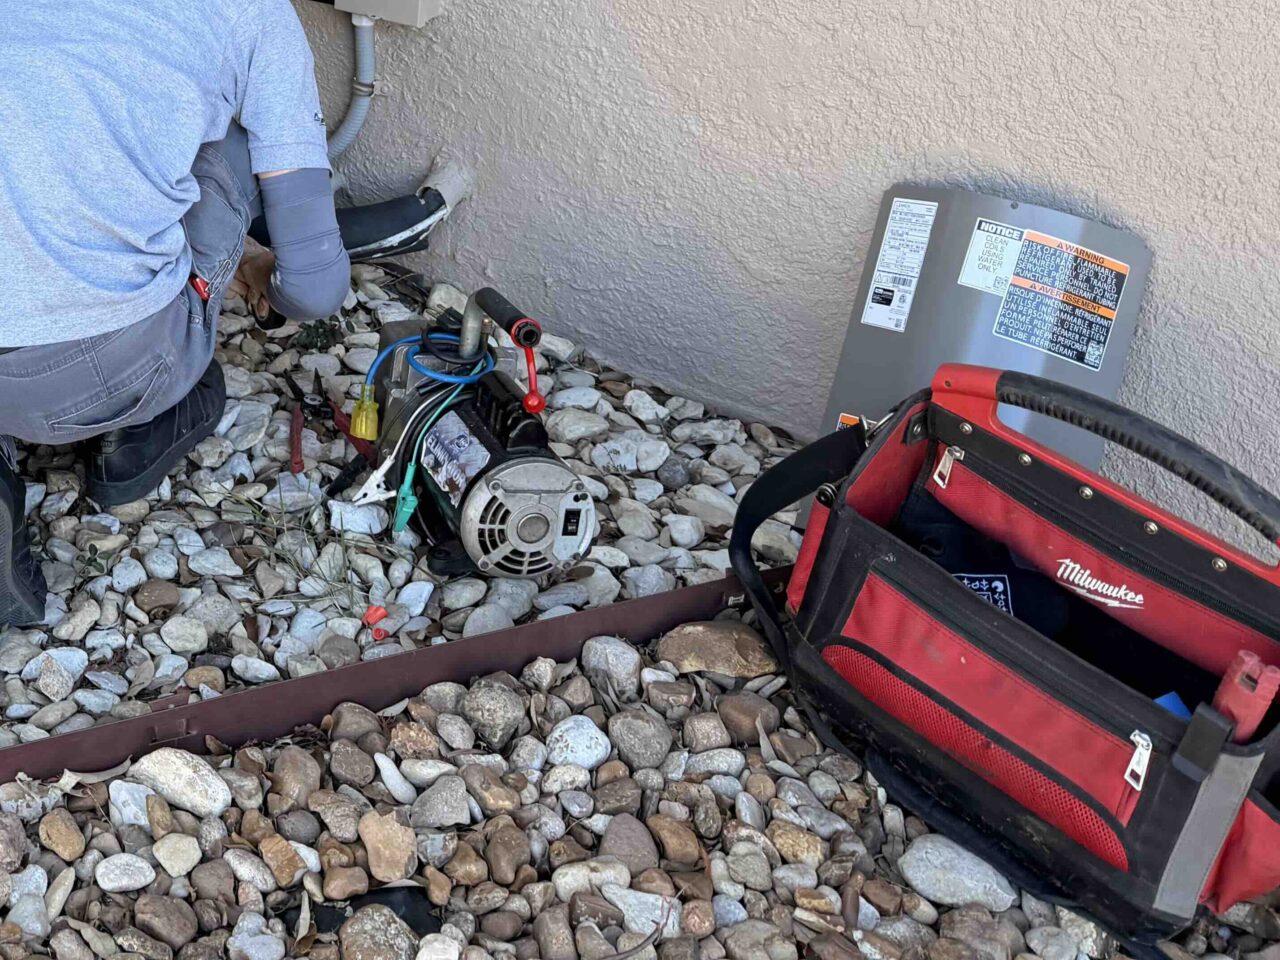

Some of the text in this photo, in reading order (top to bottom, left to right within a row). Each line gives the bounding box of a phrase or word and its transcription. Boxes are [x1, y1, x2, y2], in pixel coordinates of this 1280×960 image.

[980, 221, 1020, 239] NOTICE
[984, 241, 1005, 252] COILS
[985, 234, 1008, 246] CLEAN
[977, 255, 1002, 267] WATER
[981, 248, 1003, 260] USING
[1023, 240, 1041, 251] RISK
[1042, 246, 1054, 256] OF
[1076, 257, 1117, 278] FLAMMABLE
[1064, 244, 1105, 264] WARNING
[977, 262, 997, 274] ONLY
[1014, 267, 1052, 285] PUNCTURE
[1018, 253, 1055, 270] REPAIRED
[1058, 266, 1077, 277] ONLY
[1089, 278, 1116, 293] TRAINED
[1017, 260, 1049, 276] SERVICE
[1093, 287, 1103, 295] DO
[1104, 291, 1117, 301] NOT
[1097, 273, 1106, 281] TO
[1106, 276, 1116, 285] BE
[1008, 286, 1034, 300] RISQUE
[1038, 285, 1101, 312] AVERTISSEMENT
[1003, 301, 1016, 310] UN
[1017, 305, 1062, 325] PERSONNEL
[996, 324, 1006, 333] LE
[1006, 328, 1028, 340] TUBE
[1032, 319, 1051, 329] PEUT
[1091, 323, 1108, 335] SEUL
[1033, 328, 1044, 336] NE
[1044, 332, 1057, 341] PAS
[1057, 336, 1087, 352] PERFORER
[1057, 559, 1144, 604] Milwaukee
